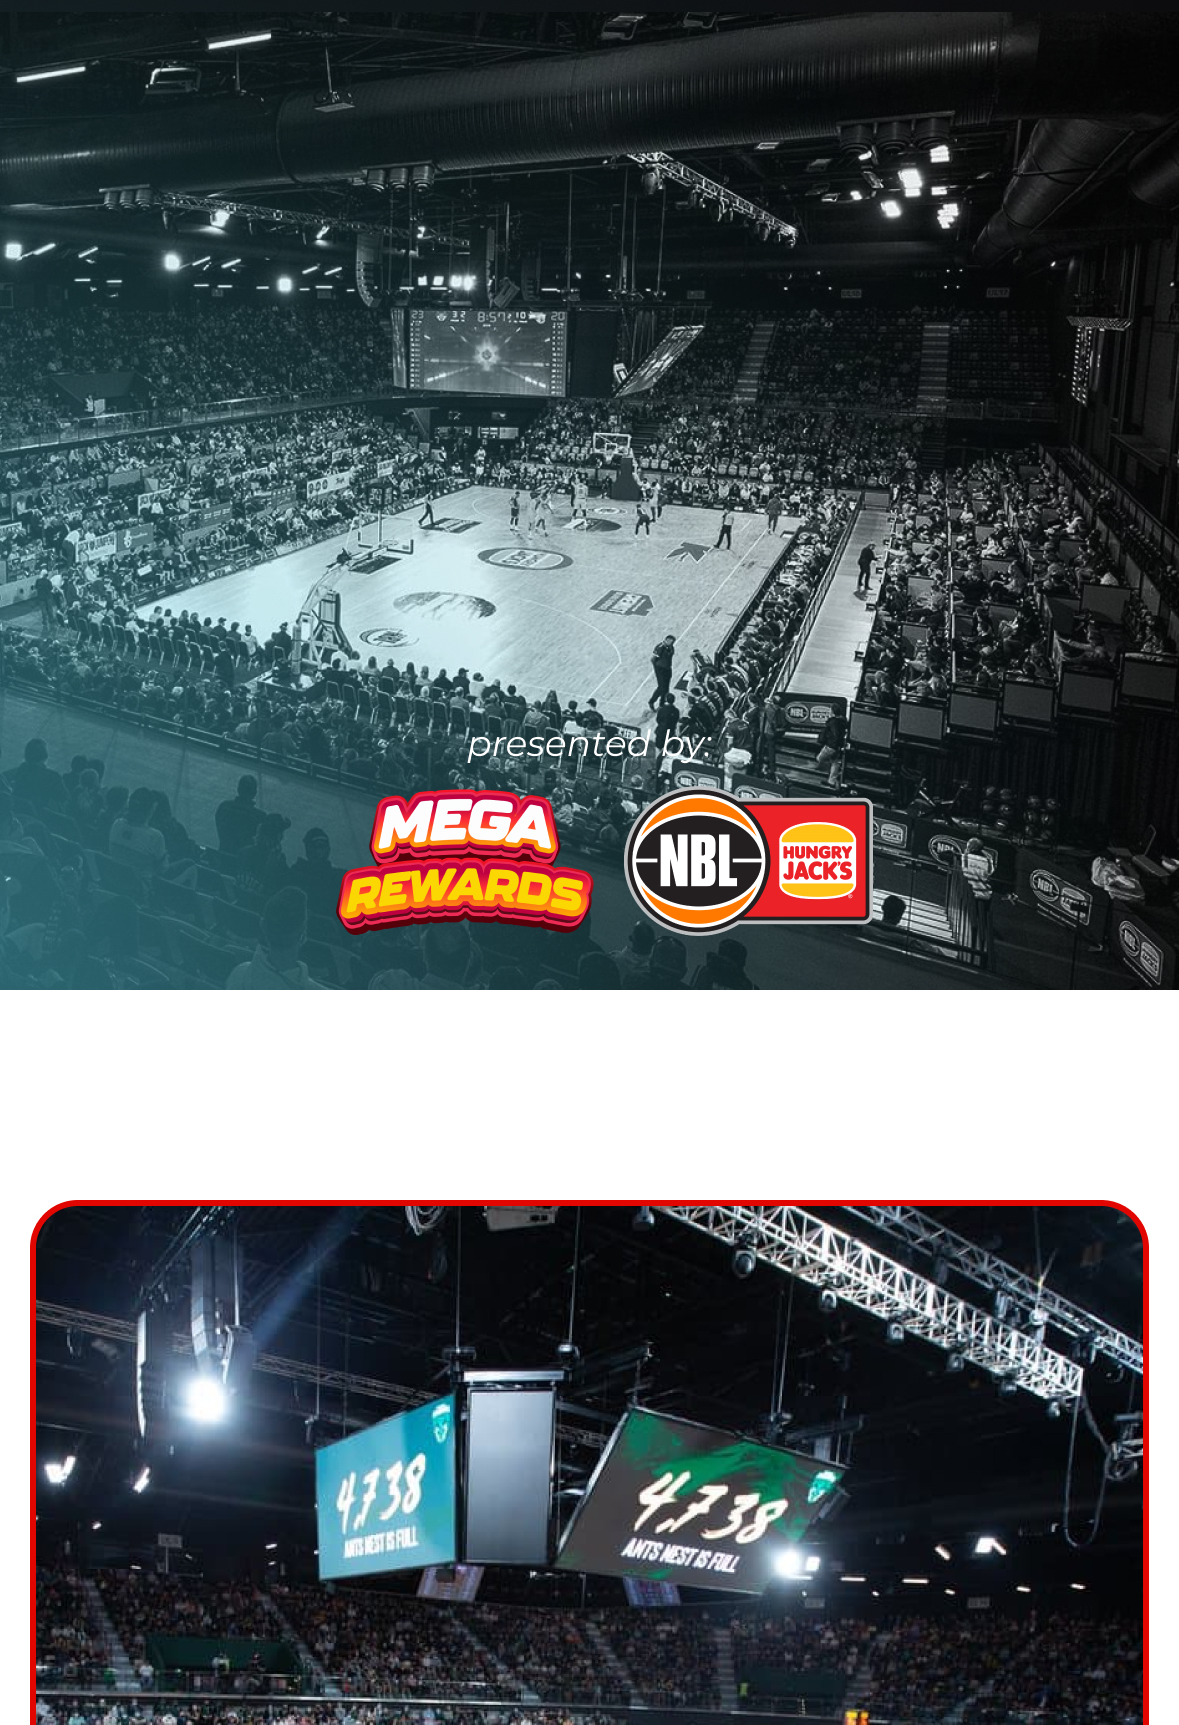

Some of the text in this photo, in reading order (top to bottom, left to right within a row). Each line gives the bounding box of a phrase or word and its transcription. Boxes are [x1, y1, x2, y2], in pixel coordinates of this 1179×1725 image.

[620, 1537, 742, 1574] ANTS NEST IS FULL
